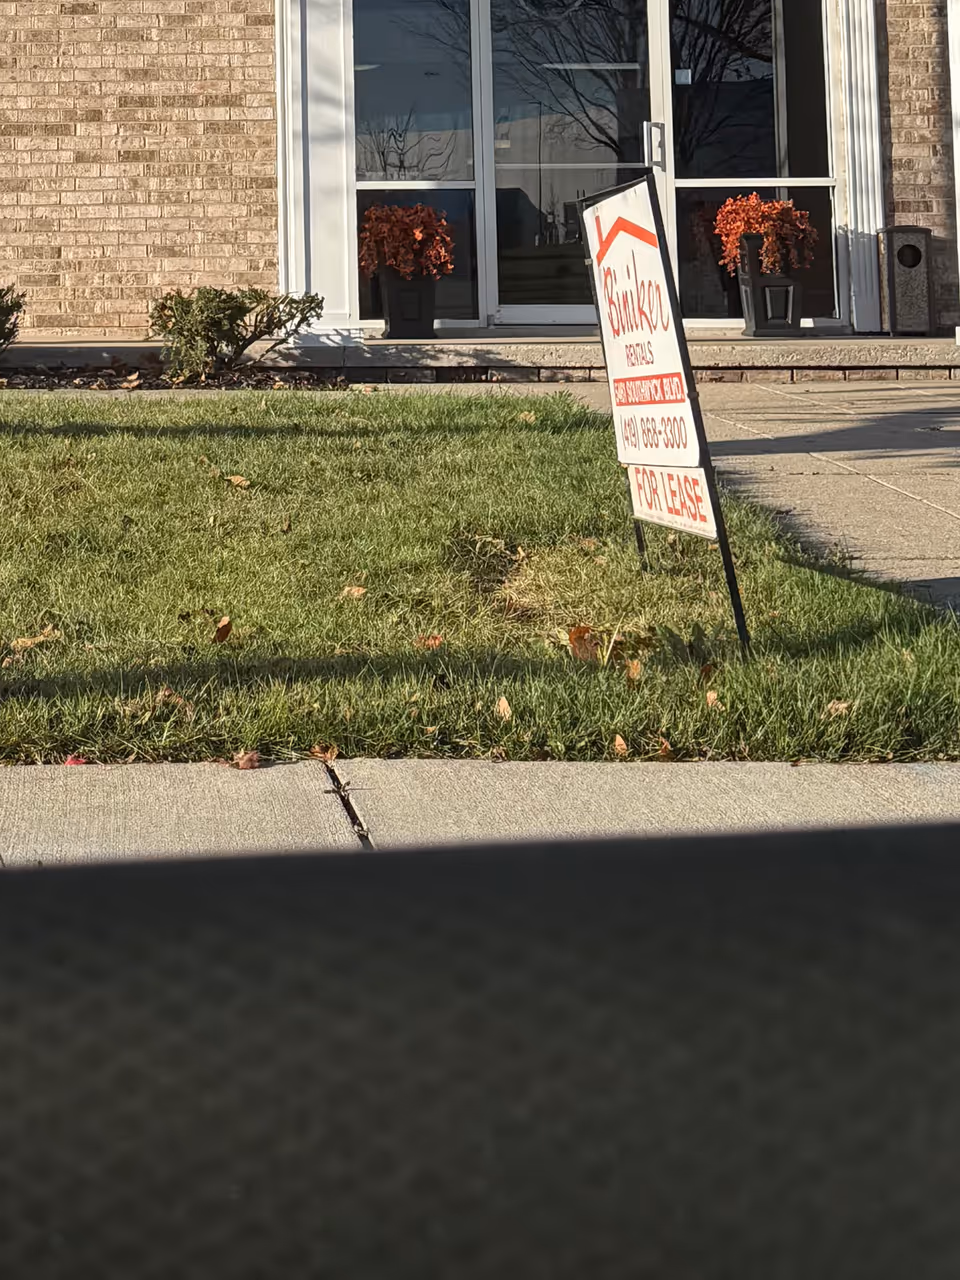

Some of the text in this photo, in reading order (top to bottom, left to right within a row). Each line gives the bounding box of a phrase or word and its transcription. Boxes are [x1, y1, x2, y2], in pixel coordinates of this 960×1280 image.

[625, 341, 654, 368] RENTALS
[620, 414, 688, 451] (419) 868-3300
[634, 467, 707, 522] FOR LEASE
